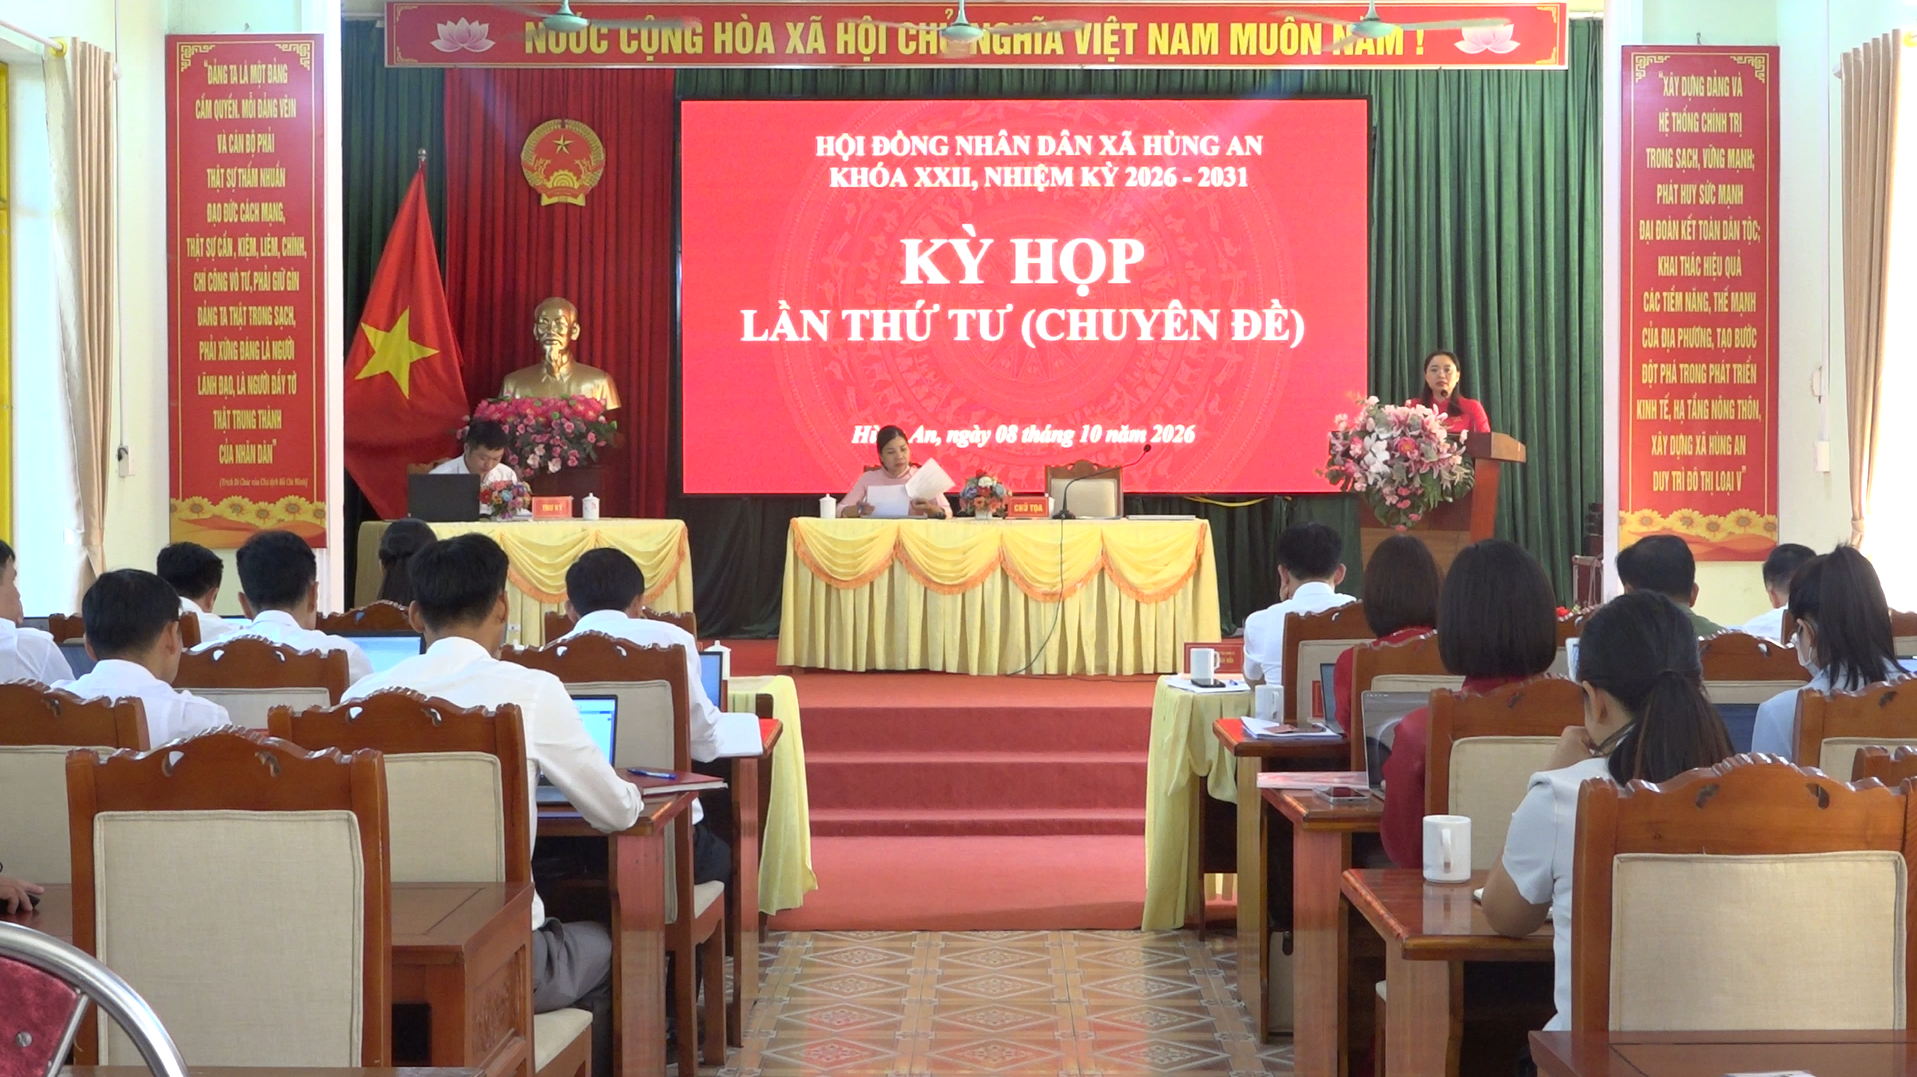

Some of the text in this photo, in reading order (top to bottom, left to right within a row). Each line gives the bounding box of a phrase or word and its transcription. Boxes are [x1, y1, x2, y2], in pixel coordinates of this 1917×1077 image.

[620, 15, 703, 61] CỘNG
[714, 13, 775, 54] HÒA
[785, 15, 826, 54] XÃ
[836, 15, 886, 62] HỘI
[1075, 15, 1138, 62] VIỆT
[1148, 23, 1219, 55] NAM
[1230, 15, 1322, 55] MUÔN
[229, 57, 288, 89] TA LÀ MỘT ĐẢNG
[1681, 69, 1743, 101] DỰNG ĐẢNG VÀ
[257, 91, 278, 118] ĐẢNG
[1658, 104, 1742, 138] HỆ THỐNG CHÍNH TRỊ
[217, 126, 275, 158] VÀ CÁN BỘ PHẢI
[815, 129, 1263, 161] HỘI ĐỒNG NHÂN DÂN XÃ HÙNG AN
[1646, 148, 1673, 168] TRONG
[1702, 144, 1725, 168] VỮNG
[207, 164, 225, 193] THẬT
[226, 166, 237, 193] SỰ
[829, 161, 1248, 192] KHÓA XXII, NHIỆM KỲ 2026 - 2031
[1657, 179, 1743, 209] PHÁT HUY SỨC MẠNH
[207, 203, 222, 227] ĐẠO
[223, 198, 238, 222] ĐỨC
[240, 198, 260, 222] CÁCH
[1639, 220, 1653, 245] ĐẠI
[1656, 215, 1679, 240] ĐOÀN
[1681, 213, 1697, 240] KẾT
[1698, 215, 1720, 240] TOÀN
[1722, 215, 1740, 240] DÂN
[186, 233, 204, 262] THẬT
[206, 235, 216, 261] SỰ
[900, 223, 1145, 297] KỲ HỌP
[193, 267, 206, 292] CHÍ
[207, 267, 228, 291] CÔNG
[229, 267, 239, 291] VÔ
[253, 264, 271, 291] PHẢI
[1658, 249, 1742, 281] KHAI THÁC HIỆU QUẢ
[198, 300, 218, 326] ĐẢNG
[219, 306, 228, 326] TA
[229, 301, 247, 331] THẬT
[248, 306, 272, 326] TRONG
[1643, 287, 1660, 312] CÁC
[1713, 285, 1729, 312] THẾ
[1731, 292, 1756, 317] MẠNH
[740, 299, 1305, 348] LẦN THỨ TƯ (CHUYÊN ĐỀ)
[1642, 320, 1659, 348] CỦA
[1661, 328, 1675, 353] ĐỊA
[1716, 328, 1732, 353] TẠO
[1734, 323, 1757, 348] BƯỚC
[199, 334, 217, 360] PHẢI
[261, 336, 271, 360] LÀ
[272, 335, 295, 360] NGƯỜI
[197, 371, 217, 395] LÃNH
[236, 371, 246, 395] LÀ
[247, 370, 270, 395] NGƯỜI
[1642, 355, 1757, 388] ĐỘT PHÁ TRONG PHÁT TRIỂN
[213, 405, 282, 434] THẬT TRUNG THÀNH
[1637, 399, 1657, 419] KINH
[1673, 399, 1685, 425] HẠ
[1711, 395, 1735, 419] NÔNG
[219, 437, 256, 464] CỦA NHÂN
[908, 424, 1196, 448] An, ngày 08 tháng 10 năm 2026
[1651, 430, 1746, 460] XÂY DỰNG XÃ HÙNG AN
[1653, 466, 1734, 496] DUY TRÌ ĐÔ THỊ LOẠI
